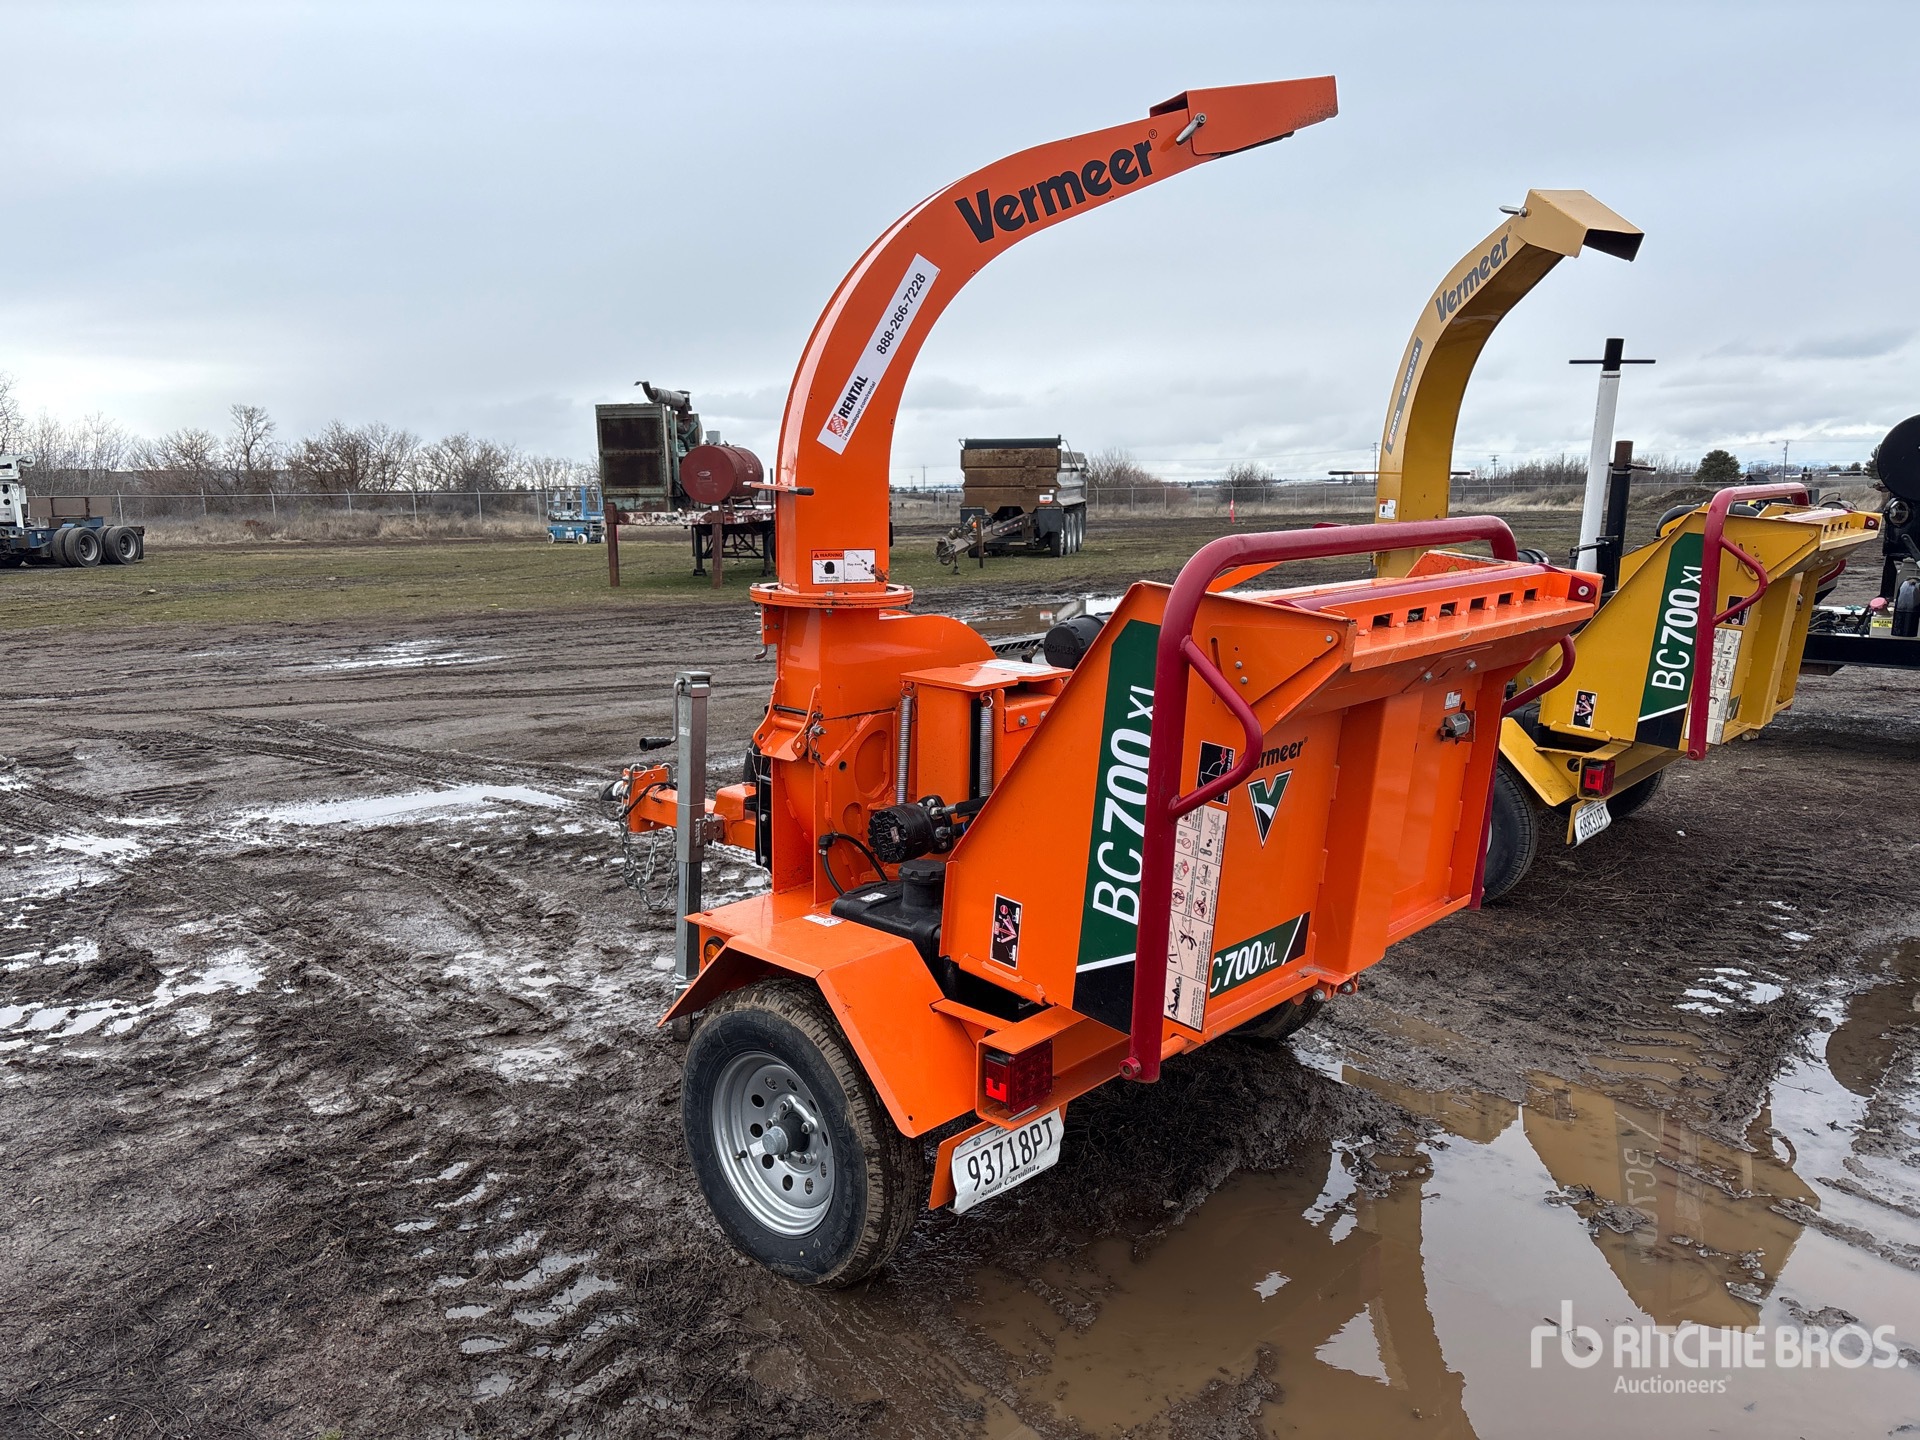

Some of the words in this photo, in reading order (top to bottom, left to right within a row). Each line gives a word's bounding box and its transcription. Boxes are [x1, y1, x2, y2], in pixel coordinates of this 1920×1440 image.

[954, 139, 1152, 244] Vermeer
[1435, 233, 1509, 323] Vermeer
[876, 272, 926, 355] 888-266-7228
[837, 375, 869, 419] RENTAL
[844, 381, 877, 437] homedepot.com/rental
[1390, 409, 1401, 434] RENTAL
[1047, 642, 1076, 655] KOHLER
[1651, 588, 1701, 691] BC700
[1092, 728, 1152, 926] BC700
[1261, 941, 1278, 970] XL
[967, 1116, 1054, 1192] 93718PT
[979, 1182, 1003, 1199] South
[1004, 1164, 1037, 1186] Carolina
